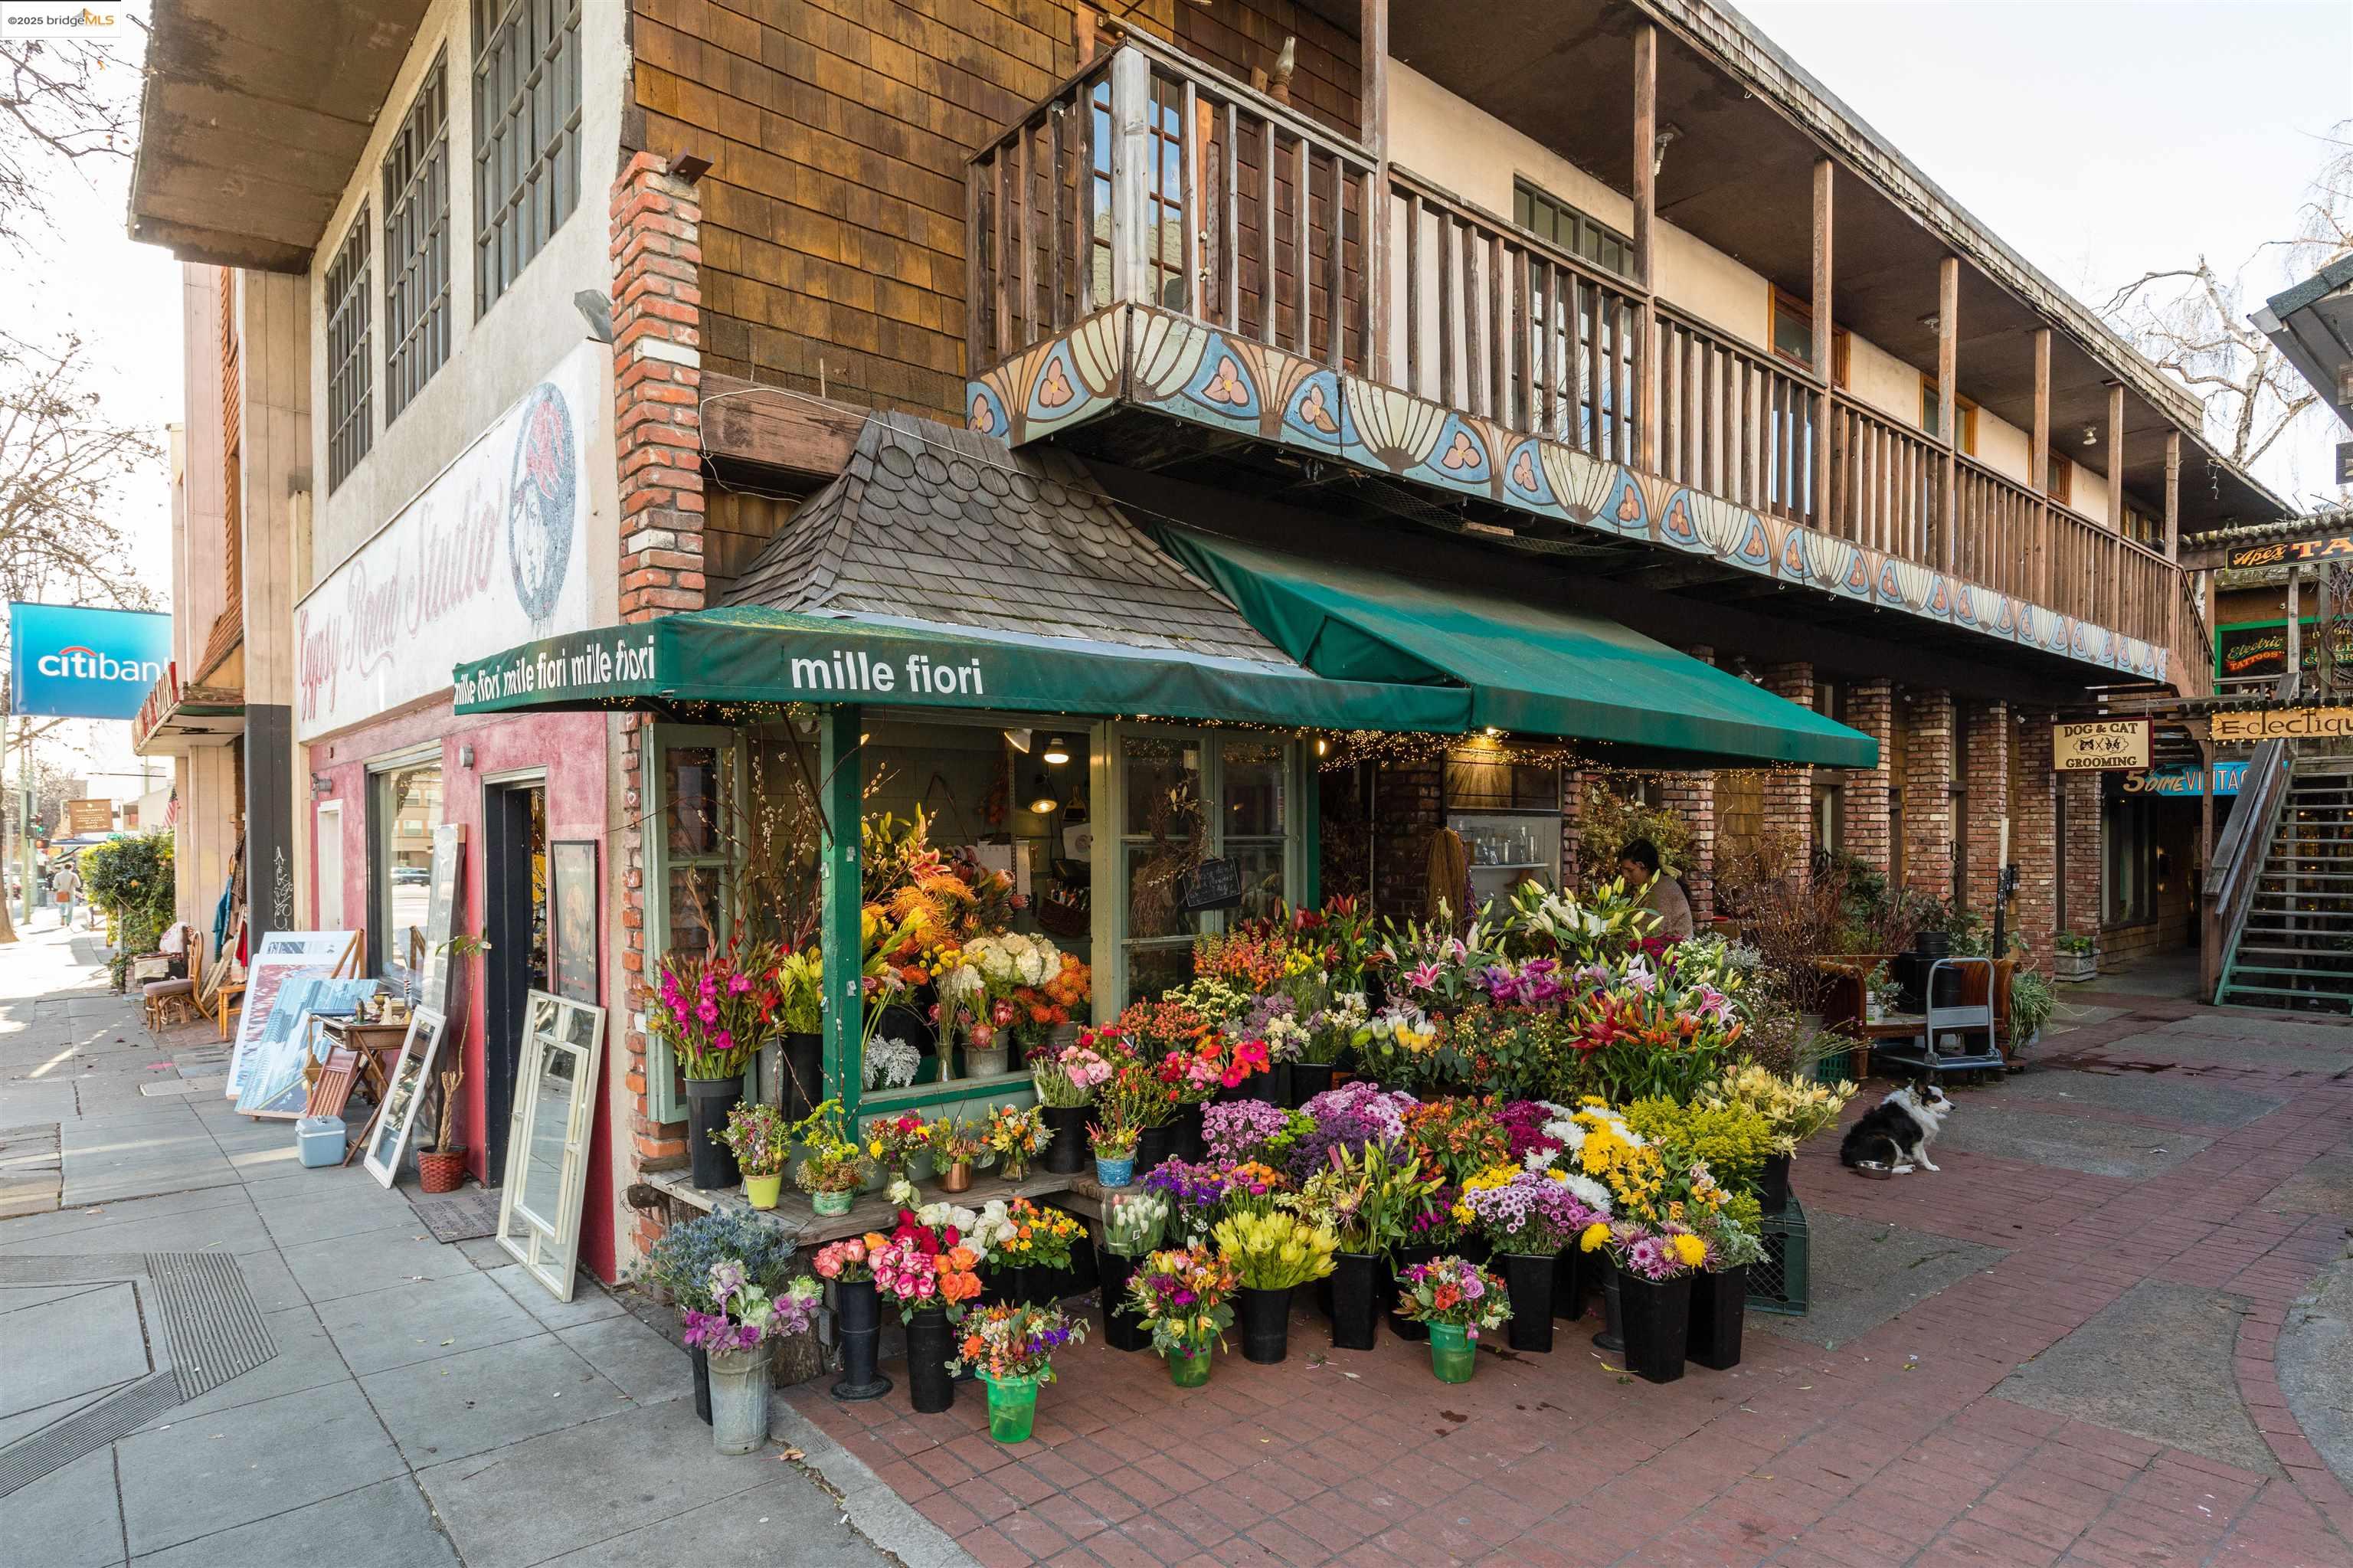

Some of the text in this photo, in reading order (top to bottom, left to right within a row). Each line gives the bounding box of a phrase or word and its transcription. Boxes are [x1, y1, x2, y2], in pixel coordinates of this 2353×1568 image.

[2233, 544, 2288, 566] Apex
[38, 646, 169, 683] citiban
[537, 648, 568, 689] fiori
[615, 635, 655, 682] fiori
[2230, 650, 2279, 670] TATTOOS
[791, 650, 983, 695] mille fiori
[2063, 722, 2138, 738] DOG & CAT
[2065, 756, 2137, 768] GROOMING
